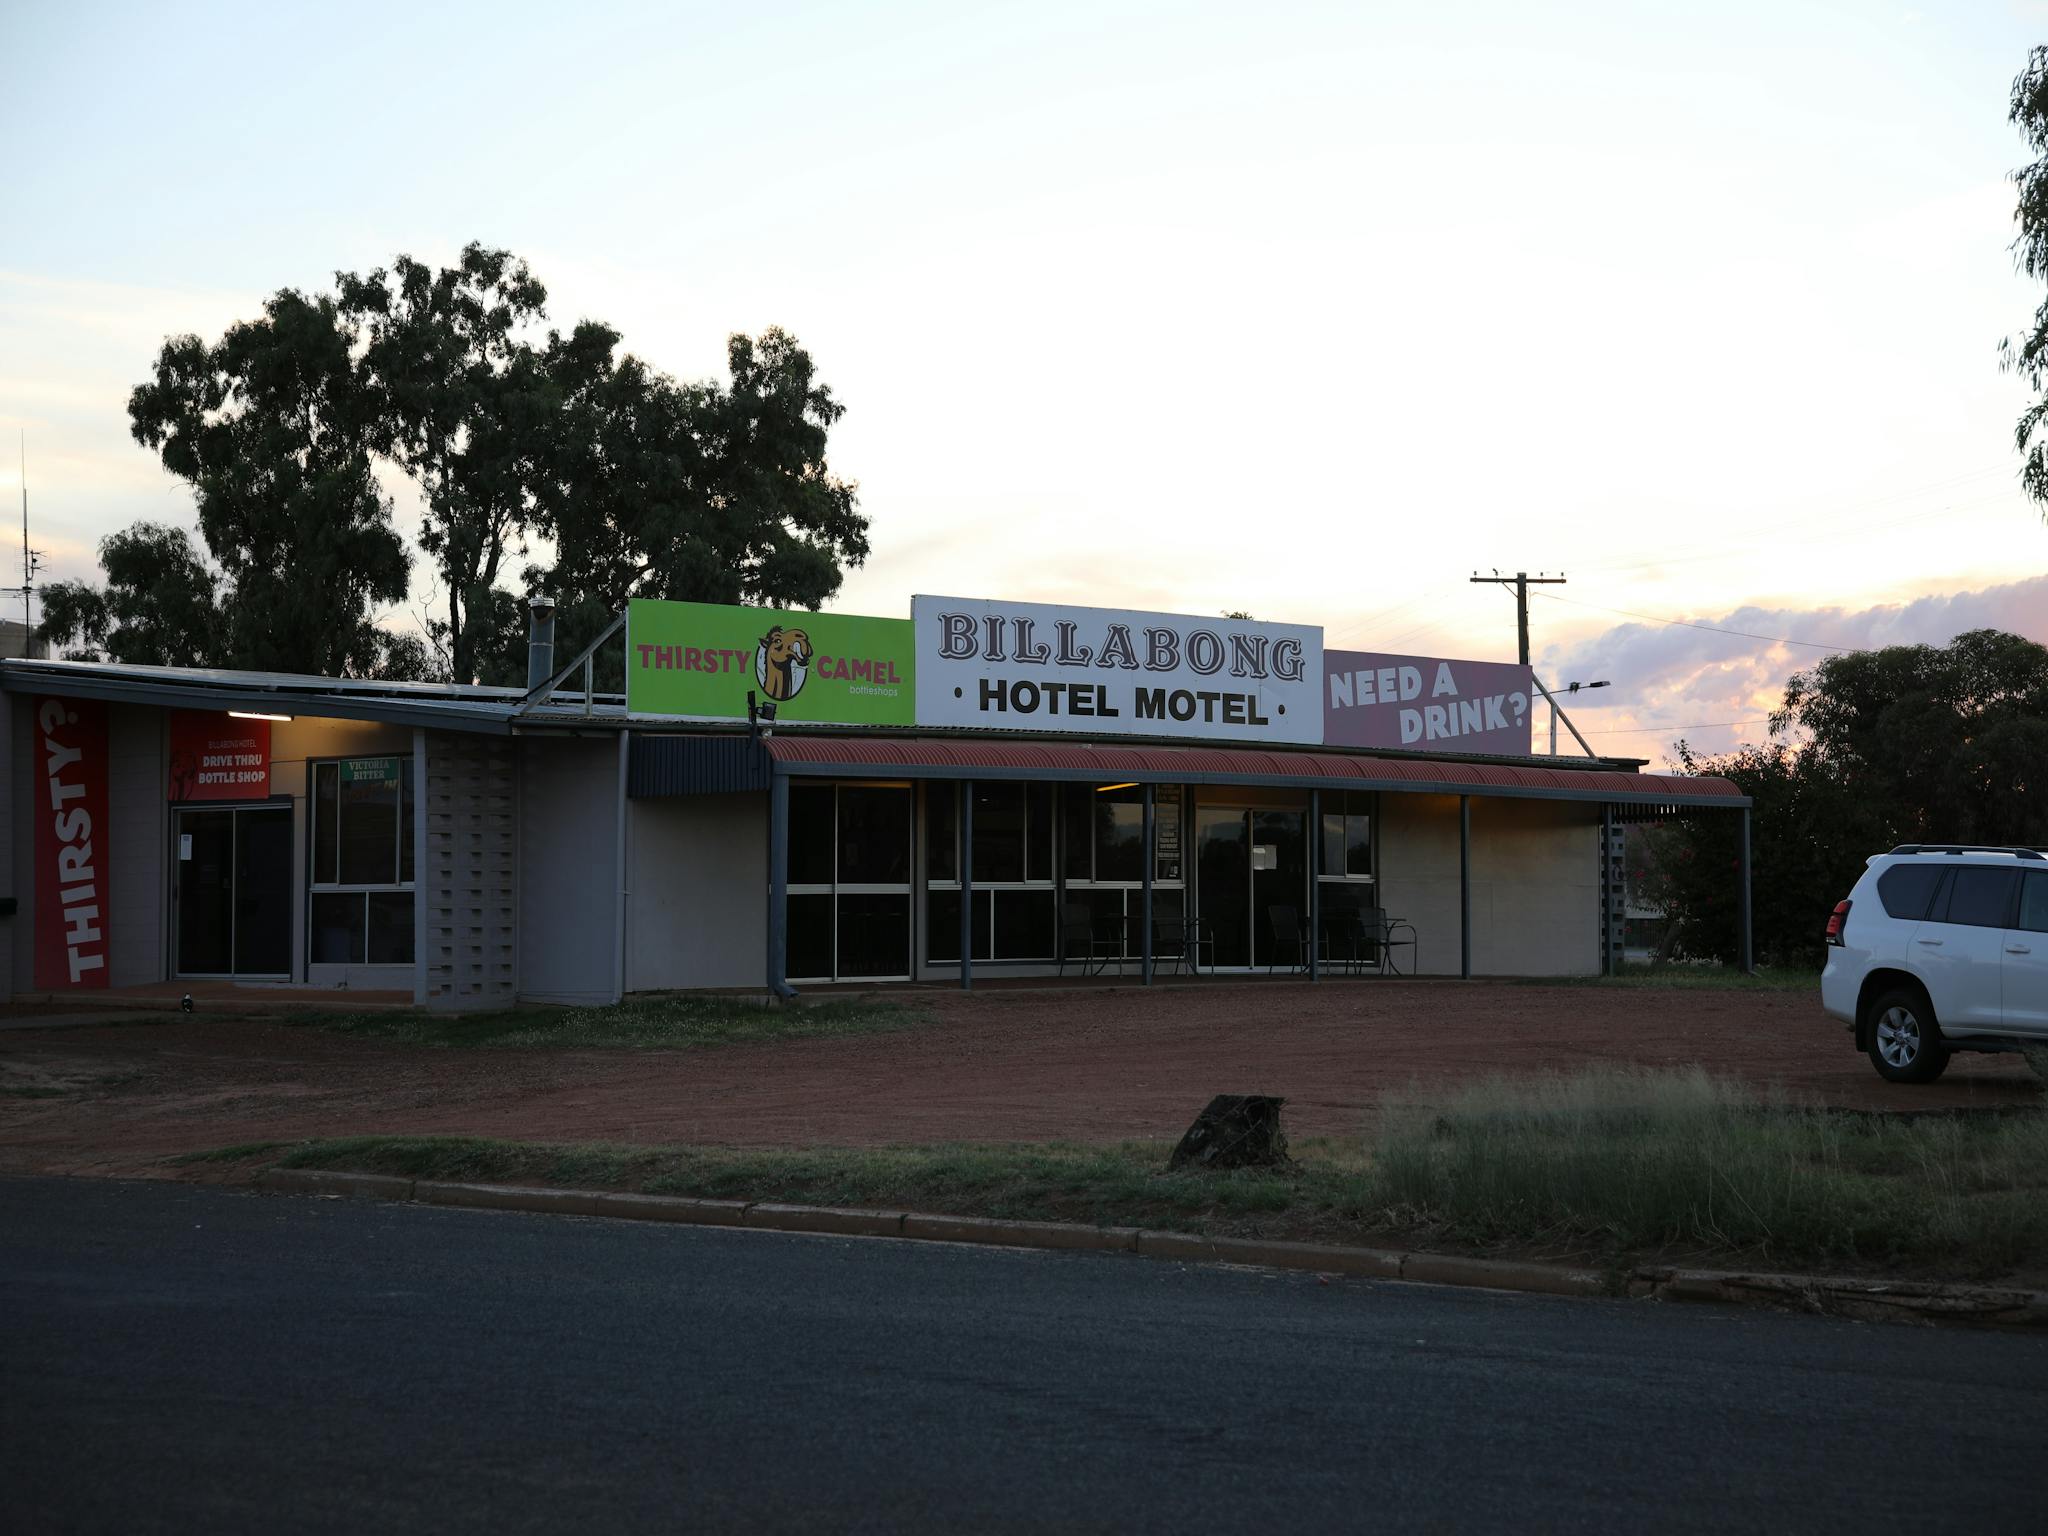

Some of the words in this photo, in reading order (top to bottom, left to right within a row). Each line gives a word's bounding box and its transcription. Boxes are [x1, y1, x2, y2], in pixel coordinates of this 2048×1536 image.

[637, 645, 751, 674] THIRSTY
[817, 656, 901, 684] CAMEL
[937, 612, 1305, 682] BILLABONG
[849, 685, 898, 697] bottleshops
[980, 679, 1118, 717] HOTEL
[1135, 687, 1268, 725] MOTEL
[1329, 666, 1422, 709] NEED
[1431, 662, 1459, 698] A
[1399, 691, 1528, 744] DRINK?
[198, 772, 236, 784] BOTTLE
[237, 771, 265, 783] SHOP
[203, 755, 233, 767] DRIVE
[235, 754, 262, 766] THRU
[349, 759, 390, 770] VICTORIA
[353, 770, 385, 780] BITTER
[39, 698, 105, 983] THIRSTY?
